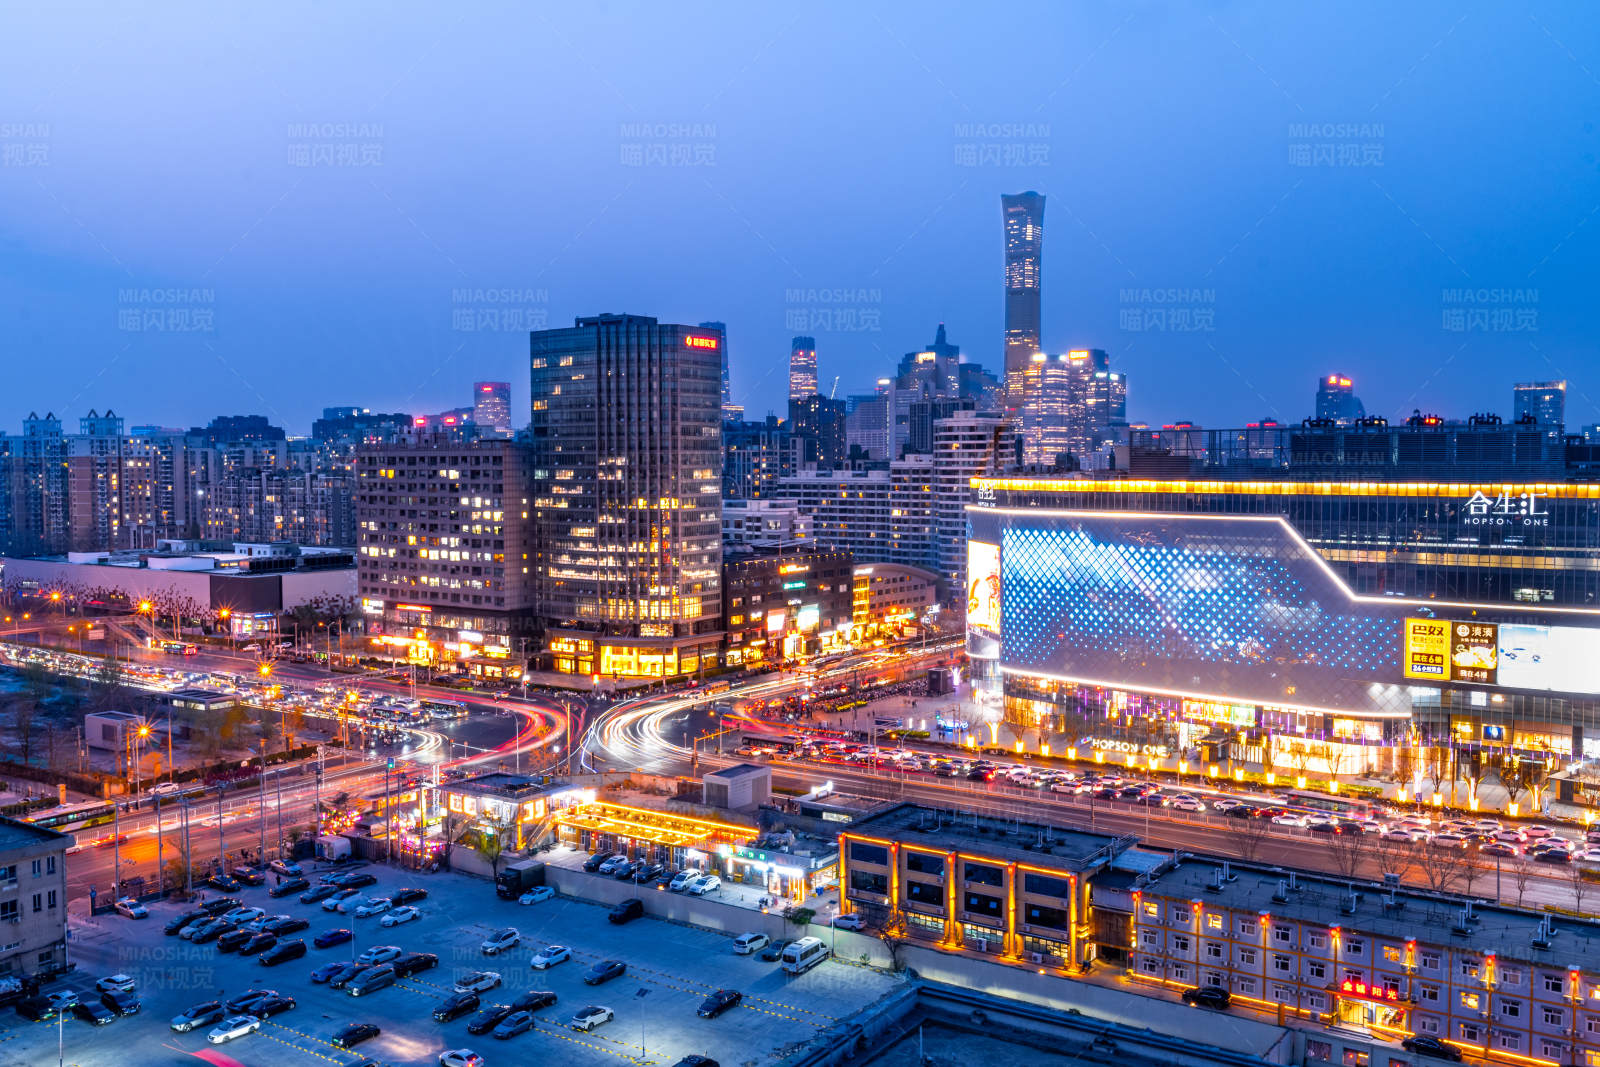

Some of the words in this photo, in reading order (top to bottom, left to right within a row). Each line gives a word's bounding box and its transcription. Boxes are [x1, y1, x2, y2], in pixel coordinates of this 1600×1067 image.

[1462, 490, 1549, 516] 合生汇
[1464, 517, 1513, 525] HOPSON
[1524, 518, 1549, 526] ONE
[1412, 624, 1444, 636] 巴奴
[1092, 738, 1139, 753] HOPSON
[1143, 744, 1167, 757] ONE
